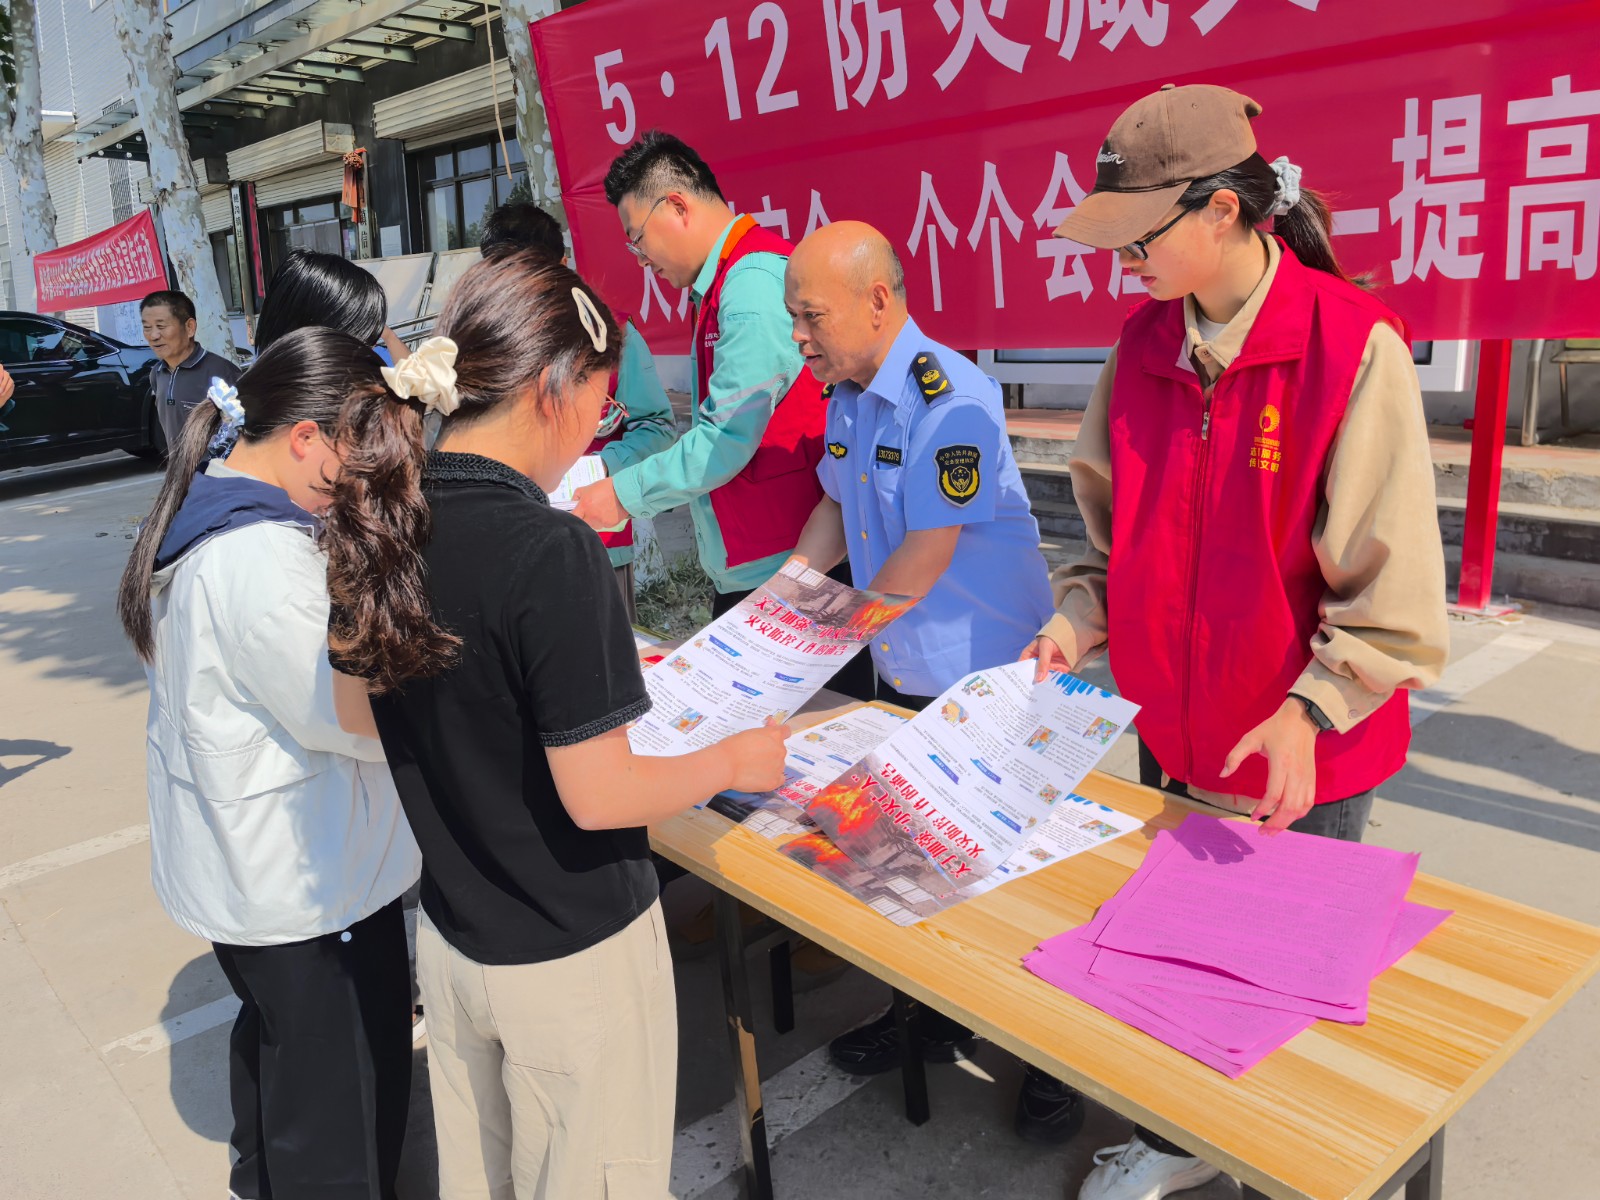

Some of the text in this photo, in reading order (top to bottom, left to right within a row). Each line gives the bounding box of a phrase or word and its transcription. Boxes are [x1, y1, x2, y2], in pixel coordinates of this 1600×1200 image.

[744, 614, 849, 657] 火灾防控工作的通告
[879, 762, 985, 860] 火灾防控工作的通告
